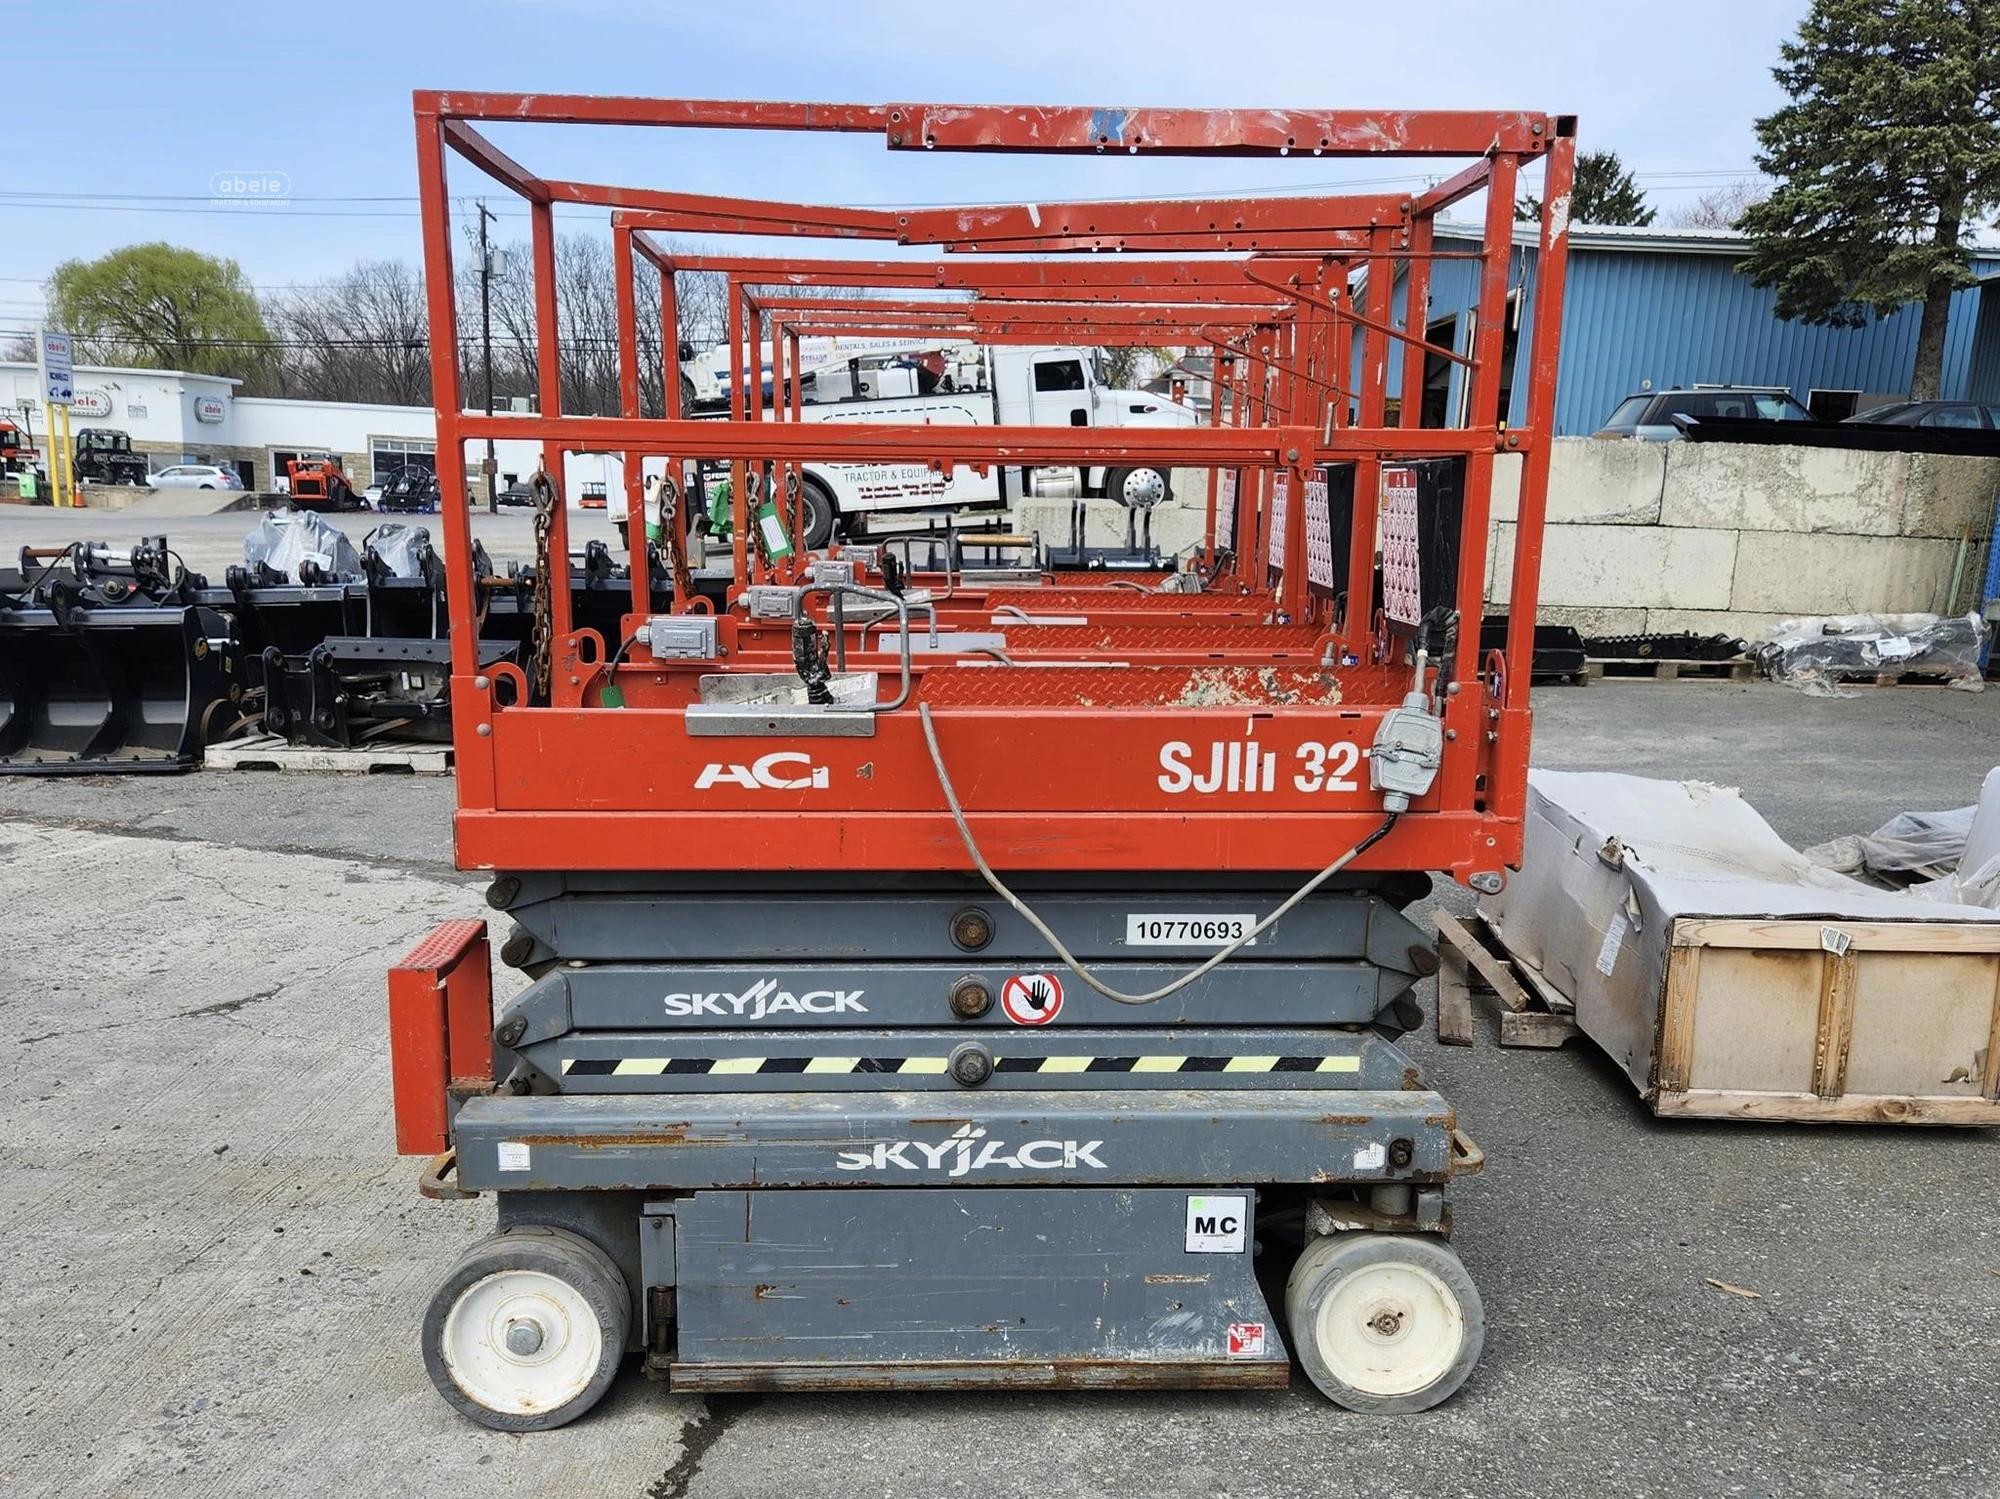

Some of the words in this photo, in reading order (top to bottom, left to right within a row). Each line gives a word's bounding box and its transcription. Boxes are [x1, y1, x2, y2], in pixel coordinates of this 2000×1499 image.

[869, 341, 892, 349] SALES
[899, 338, 927, 347] SERVICE
[204, 403, 221, 414] abele
[844, 471, 888, 483] TRACTOR
[890, 471, 897, 479] &
[1137, 921, 1243, 939] 10770693
[664, 978, 869, 1020] SKYJACK
[836, 1123, 1108, 1177] SKYJACK
